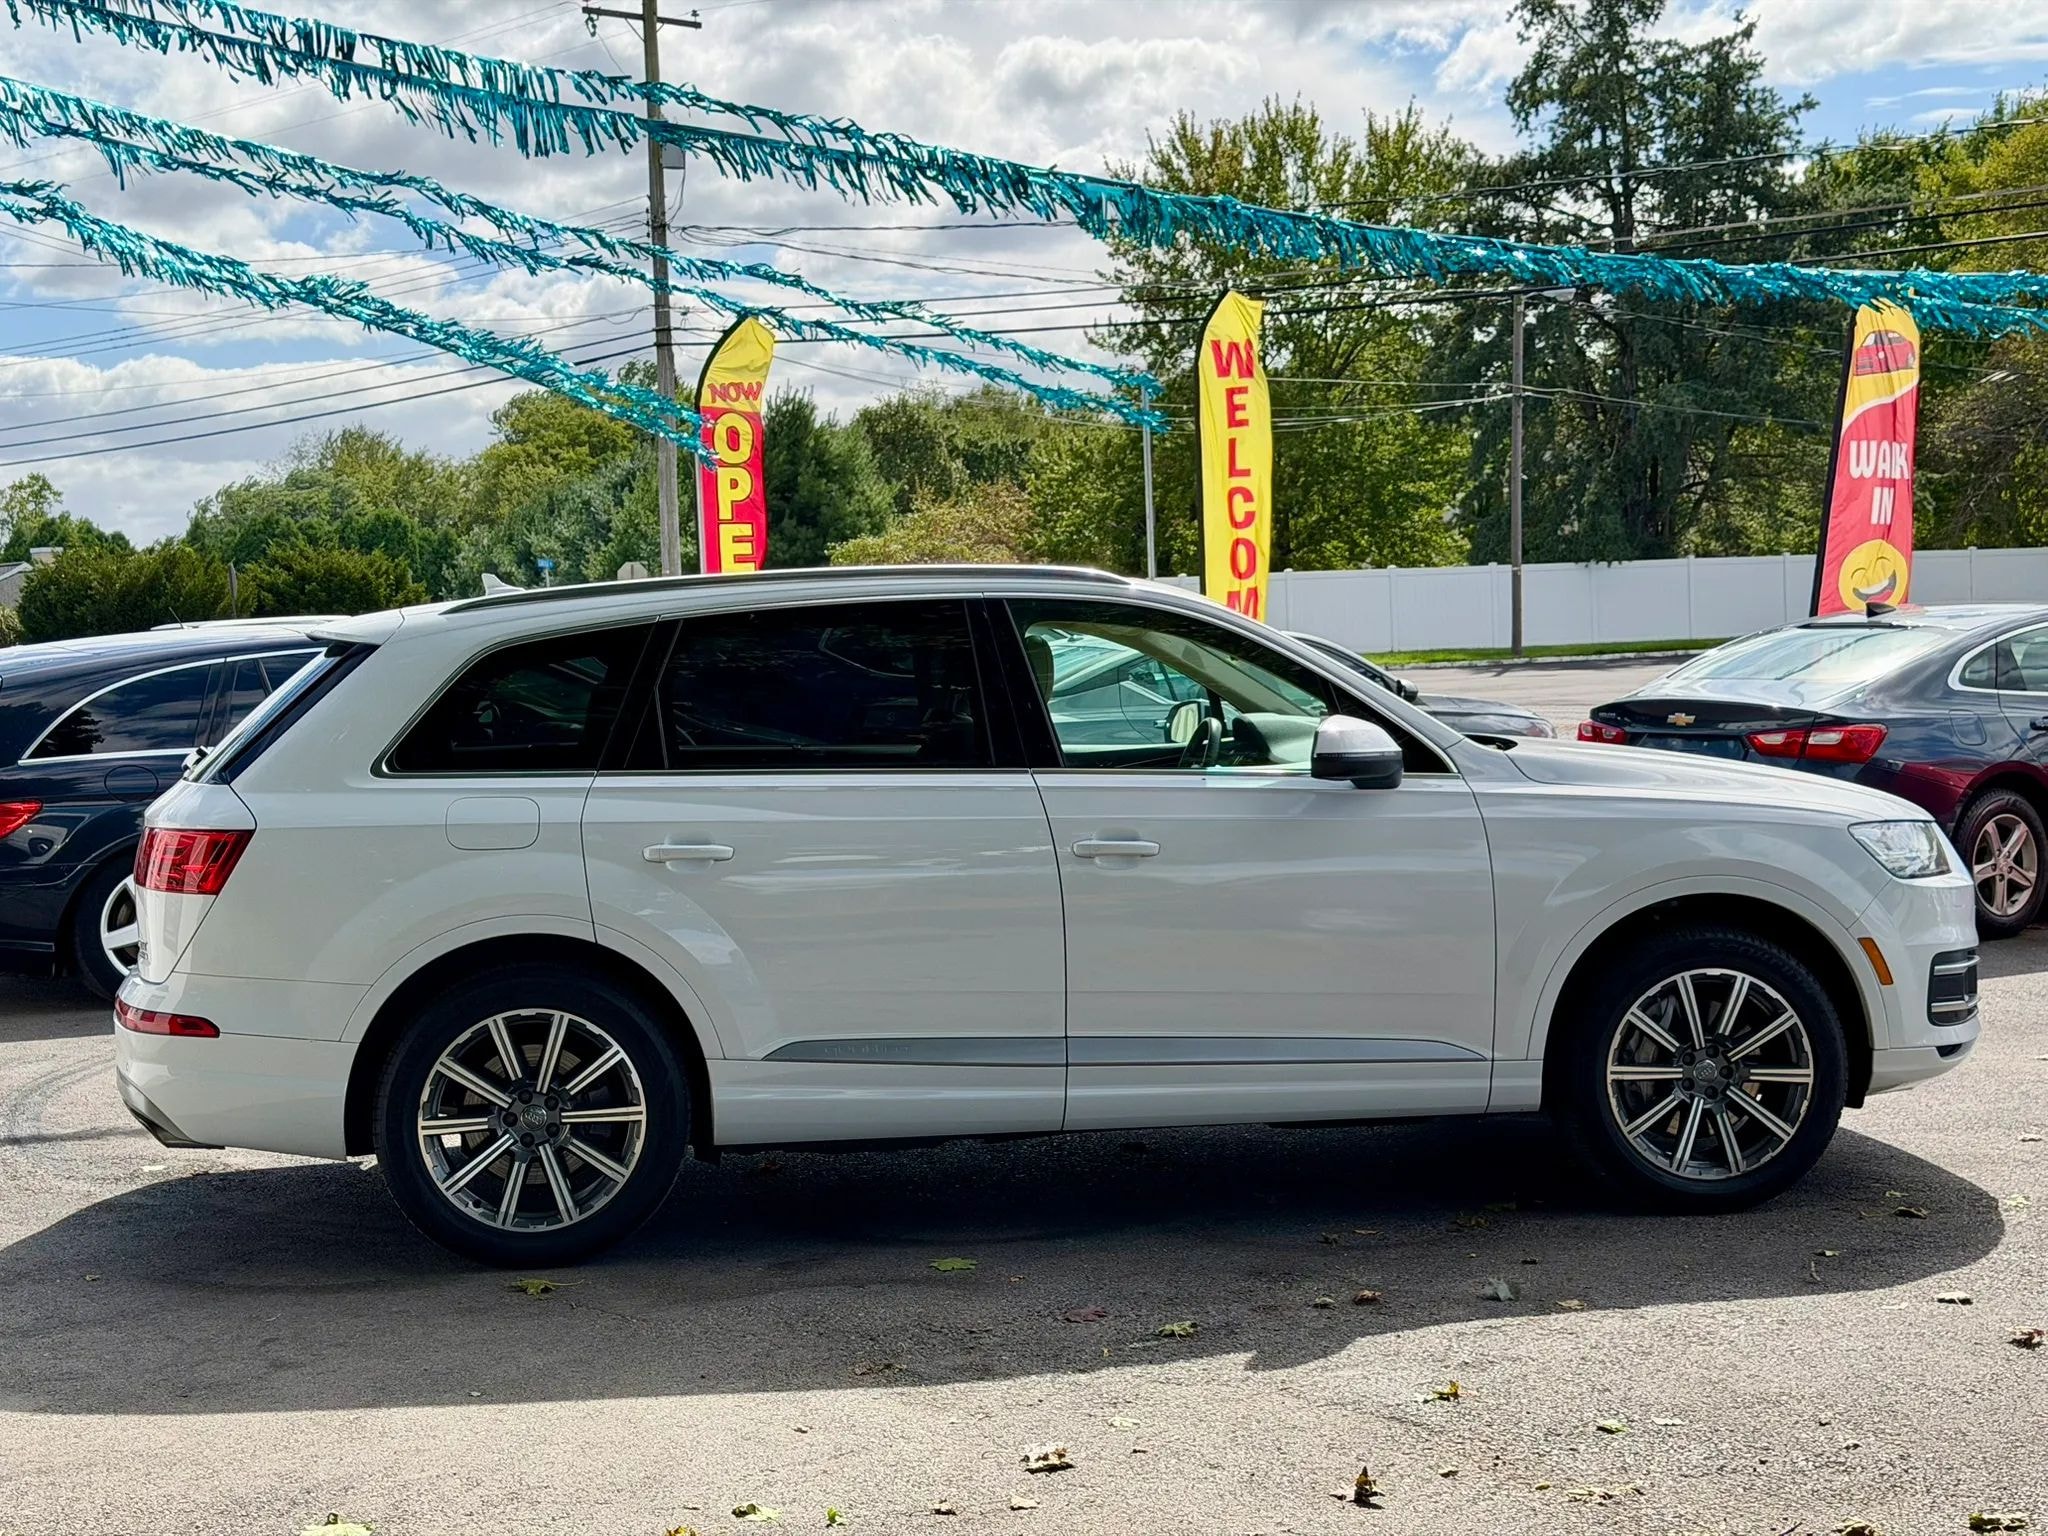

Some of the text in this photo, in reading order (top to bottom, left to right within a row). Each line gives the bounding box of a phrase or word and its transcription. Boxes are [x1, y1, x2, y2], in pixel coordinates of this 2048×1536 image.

[707, 381, 762, 403] NOW
[713, 411, 756, 573] OPE
[1870, 486, 1894, 525] IN
